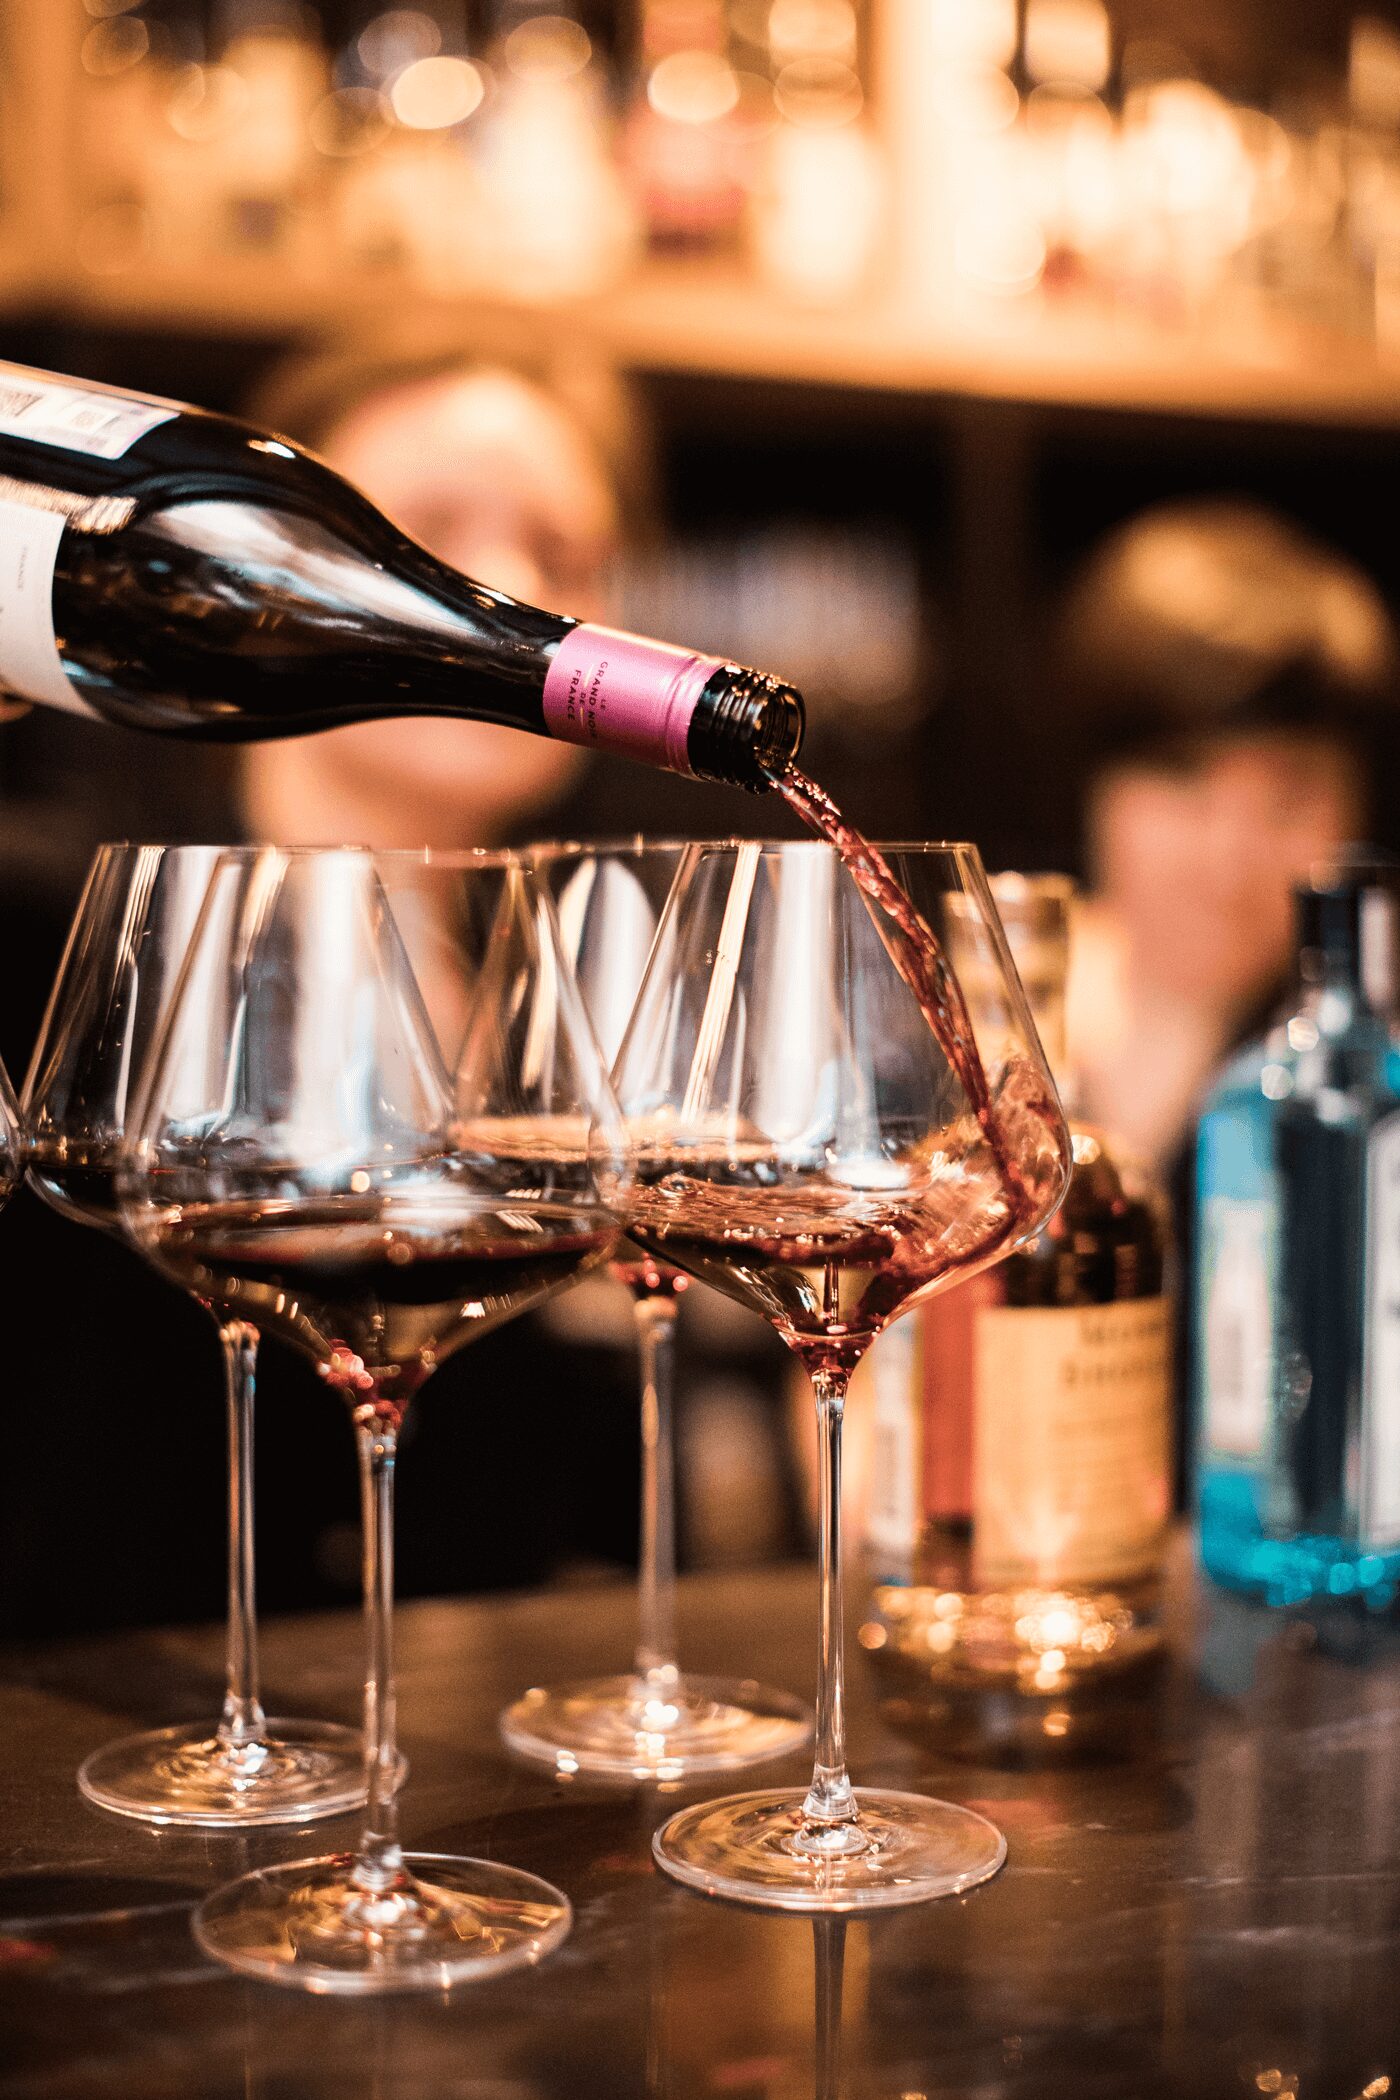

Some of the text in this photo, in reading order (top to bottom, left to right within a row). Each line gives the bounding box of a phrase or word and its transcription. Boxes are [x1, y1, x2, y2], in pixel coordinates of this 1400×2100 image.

[567, 669, 582, 721] FRANCE
[579, 692, 587, 705] DE
[588, 661, 609, 706] GRAND
